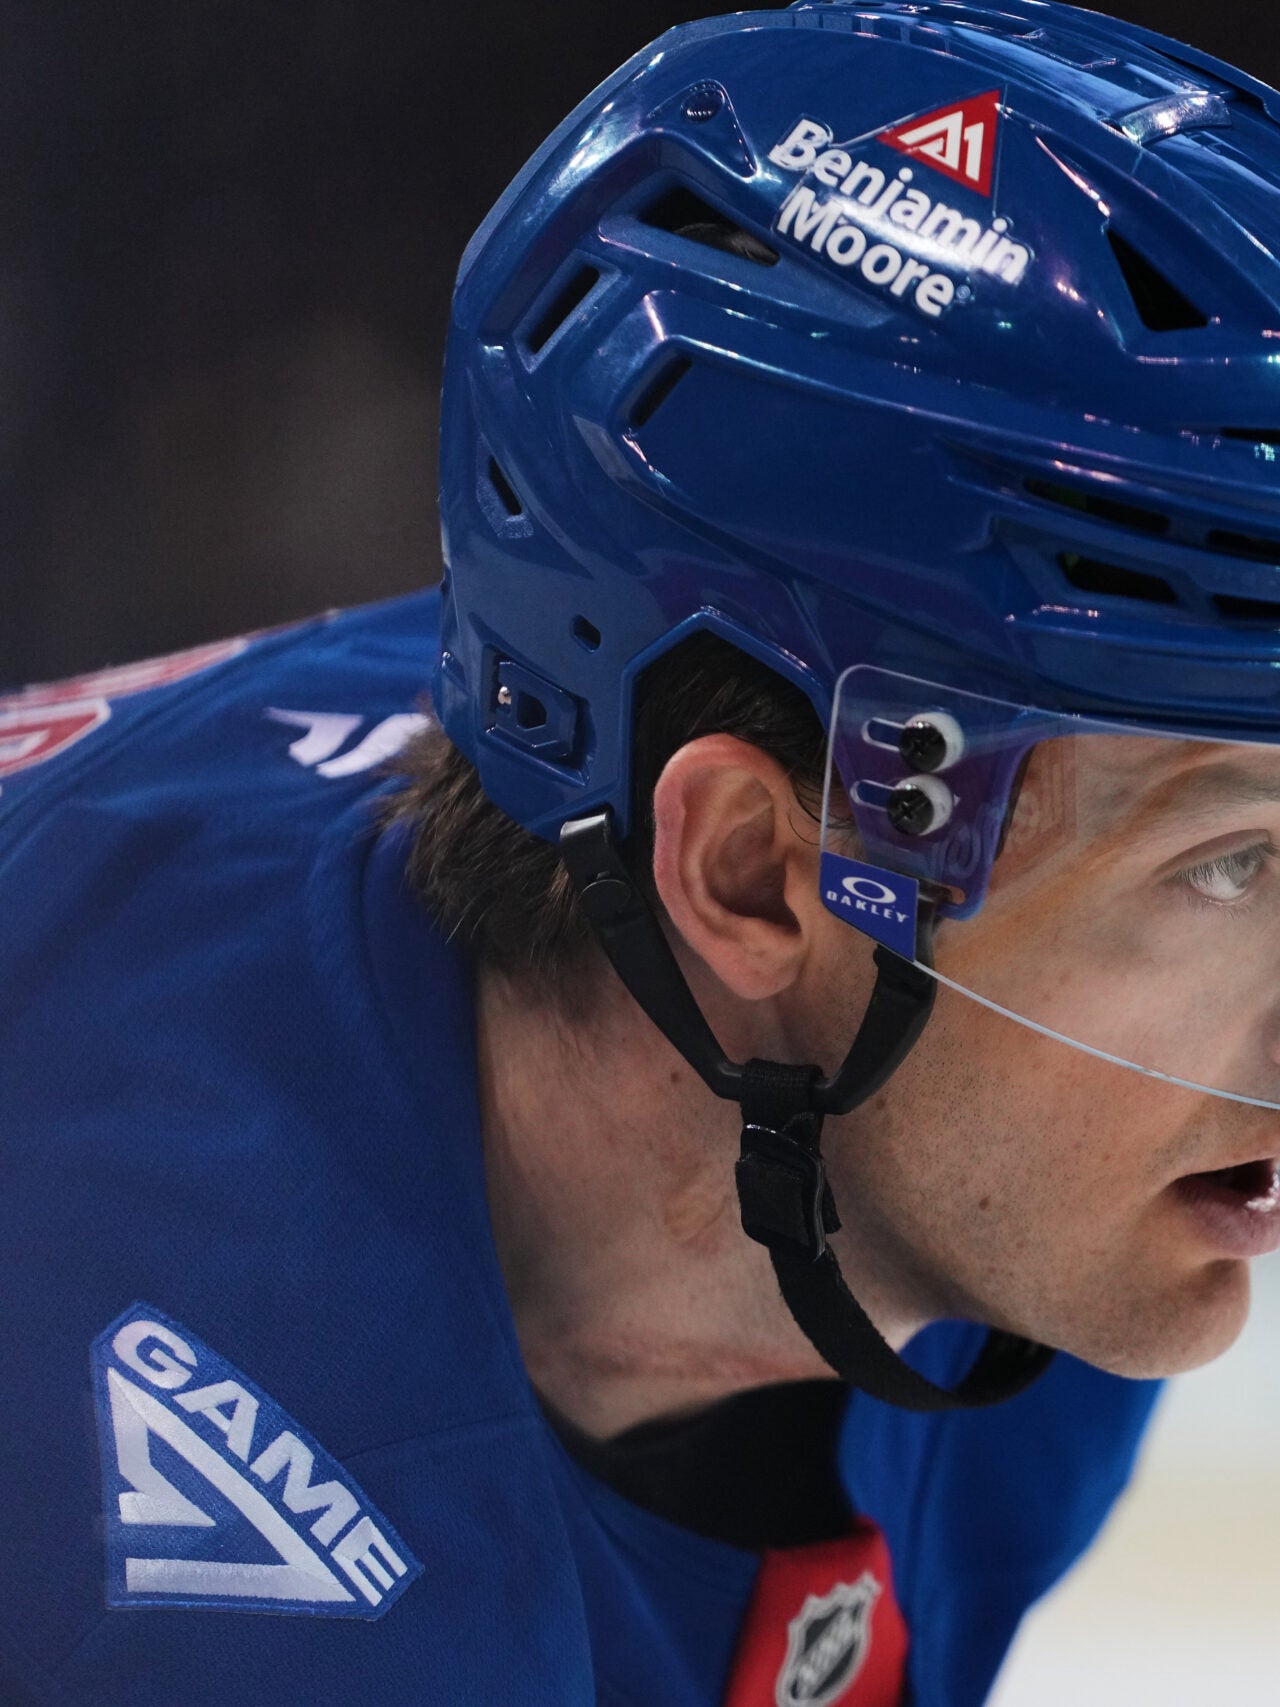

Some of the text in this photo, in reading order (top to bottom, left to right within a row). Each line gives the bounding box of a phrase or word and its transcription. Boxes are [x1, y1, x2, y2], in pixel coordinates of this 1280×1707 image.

[768, 118, 1030, 285] Benjamin
[826, 890, 909, 923] OAKLEY
[112, 1320, 408, 1607] GAME
